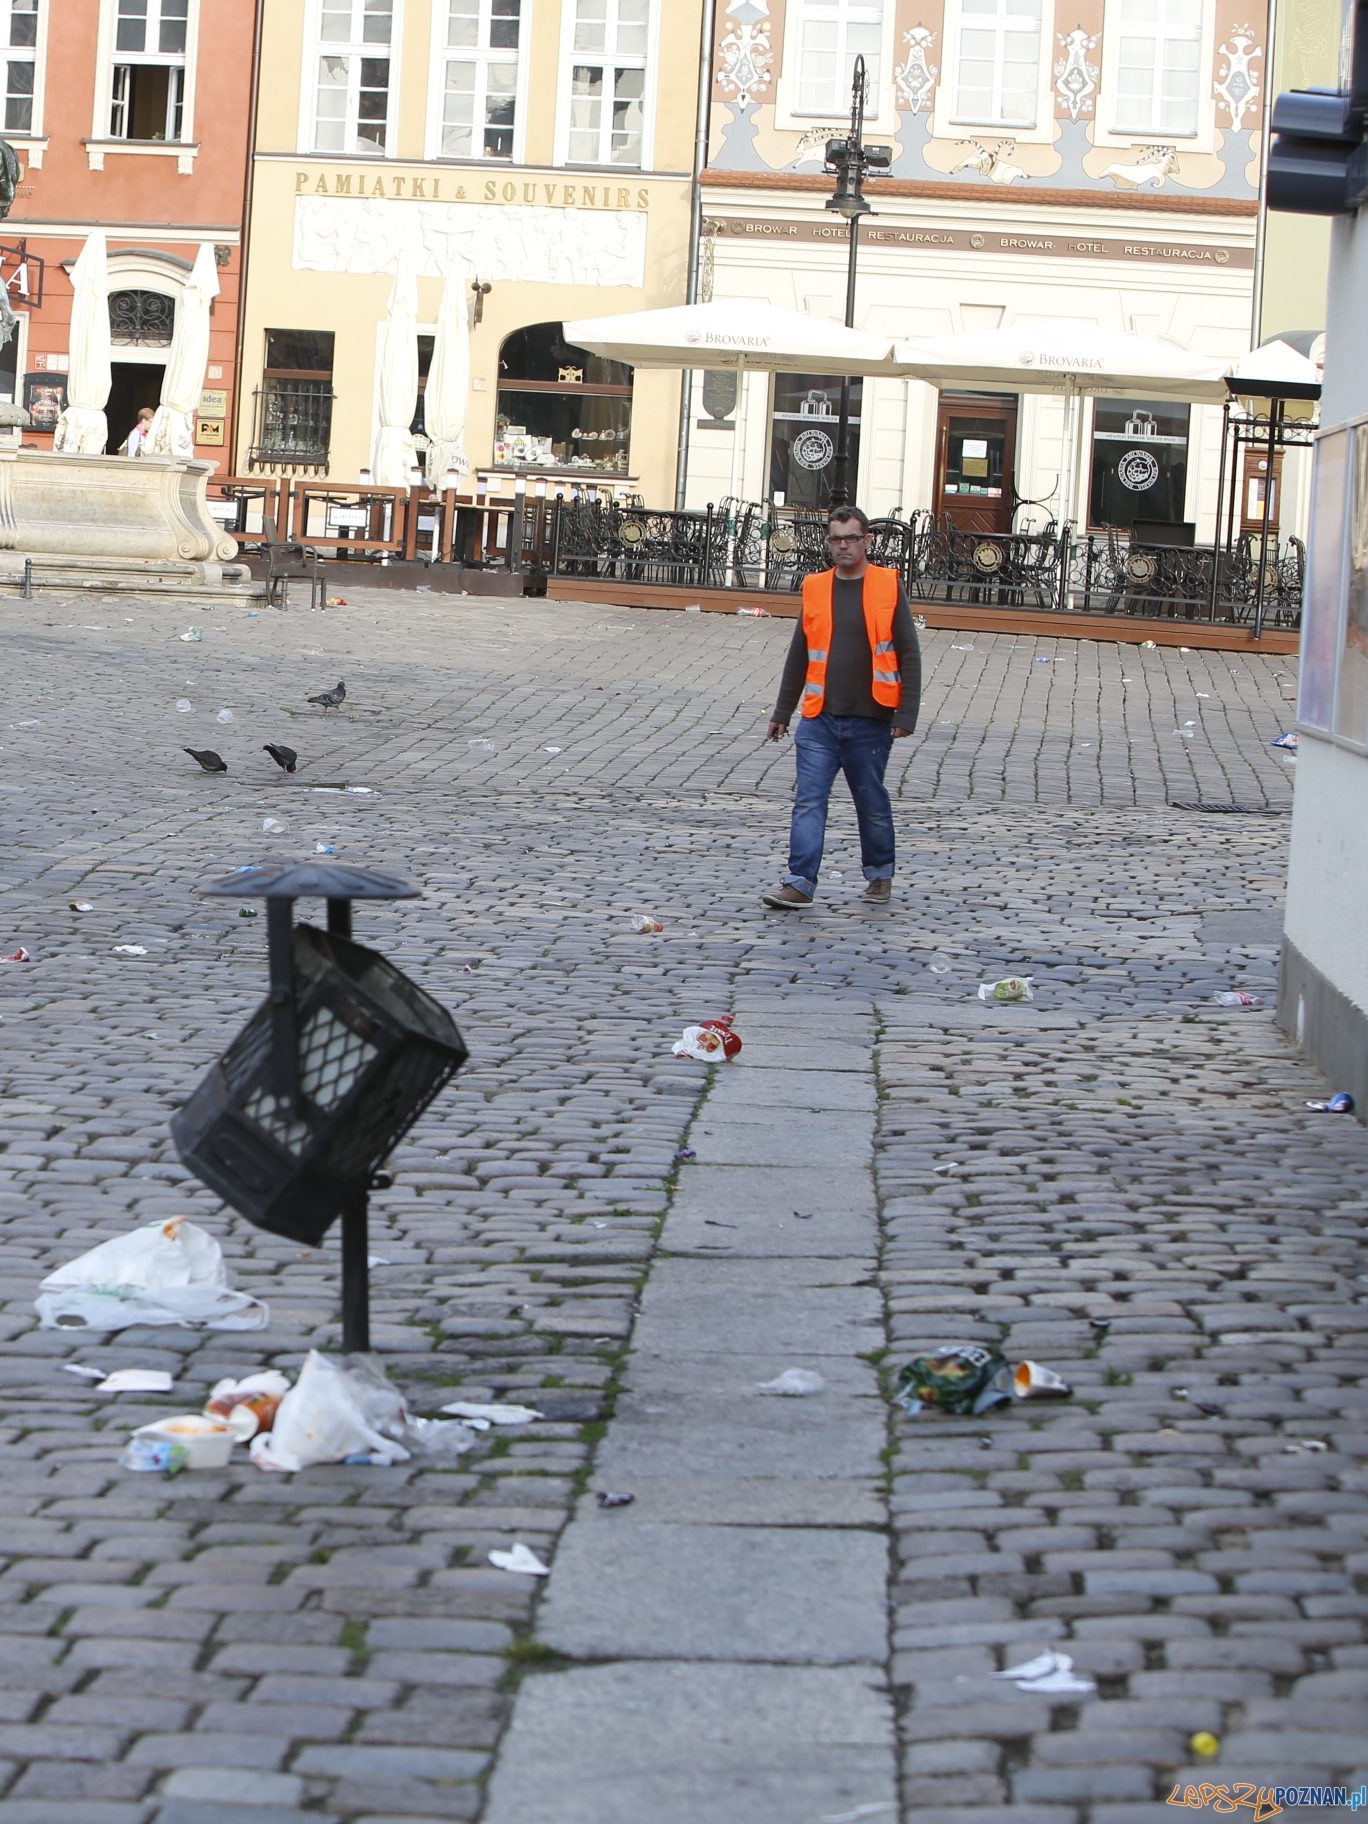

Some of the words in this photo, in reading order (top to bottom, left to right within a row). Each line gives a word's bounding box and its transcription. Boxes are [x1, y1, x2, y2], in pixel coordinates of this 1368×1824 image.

[295, 172, 441, 198] PAMIĄTKI
[455, 185, 467, 199] &
[484, 180, 650, 208] SOUVENIRS
[745, 224, 797, 235] BROWAR
[812, 228, 851, 238] HOTEL
[868, 231, 954, 244] RESTAURACJA
[1000, 238, 1053, 250] BROWAR
[1068, 242, 1108, 254] HOTEL
[1124, 245, 1211, 261] RESTAURACJA
